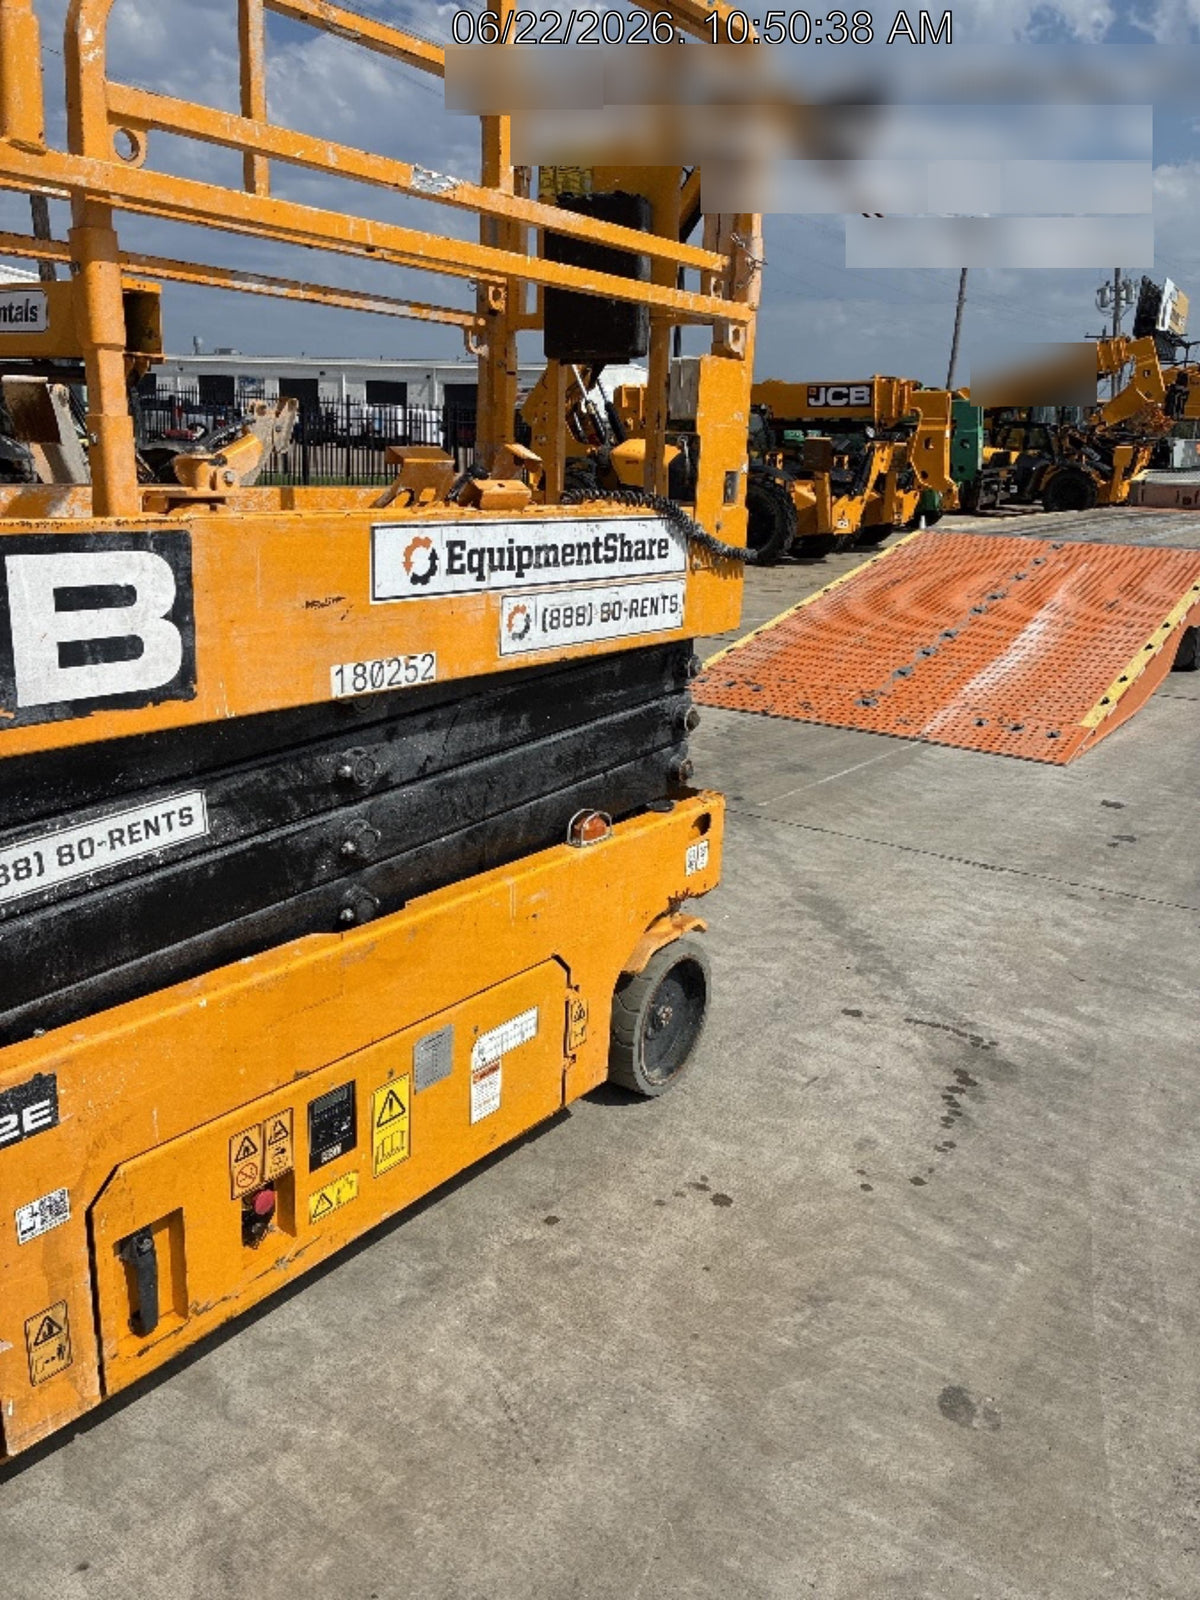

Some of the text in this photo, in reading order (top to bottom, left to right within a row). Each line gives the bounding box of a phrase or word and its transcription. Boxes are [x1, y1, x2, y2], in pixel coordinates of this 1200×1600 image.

[808, 386, 870, 406] JCB
[446, 533, 669, 581] EquipmentShare
[5, 551, 183, 708] B
[541, 594, 678, 633] (888) 80-RENTS
[336, 654, 434, 693] 180252
[56, 806, 194, 867] 80-RENTS
